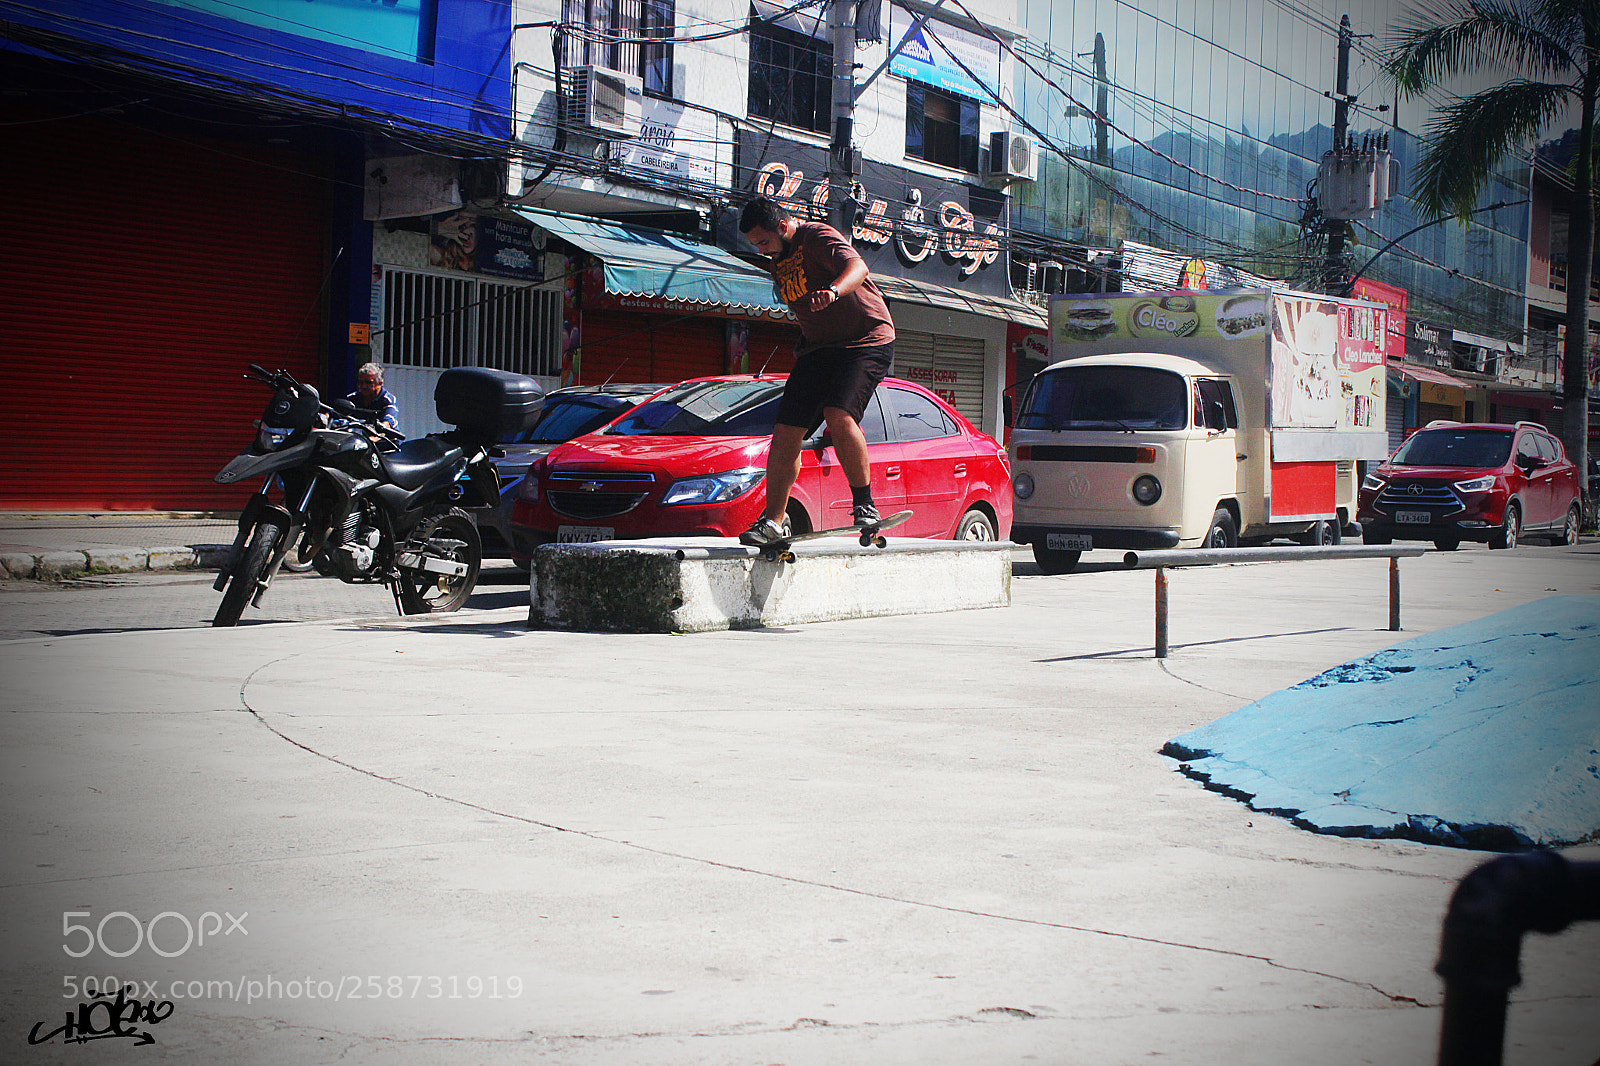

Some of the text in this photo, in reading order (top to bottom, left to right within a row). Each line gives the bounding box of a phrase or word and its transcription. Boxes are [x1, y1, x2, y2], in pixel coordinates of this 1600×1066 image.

[641, 155, 679, 171] CABELEIREIRA
[495, 219, 529, 235] Manicure
[495, 232, 512, 244] hora
[1138, 309, 1177, 331] Cléo
[1344, 346, 1383, 364] Cleo Lanches
[907, 367, 958, 383] ASSESSORAR
